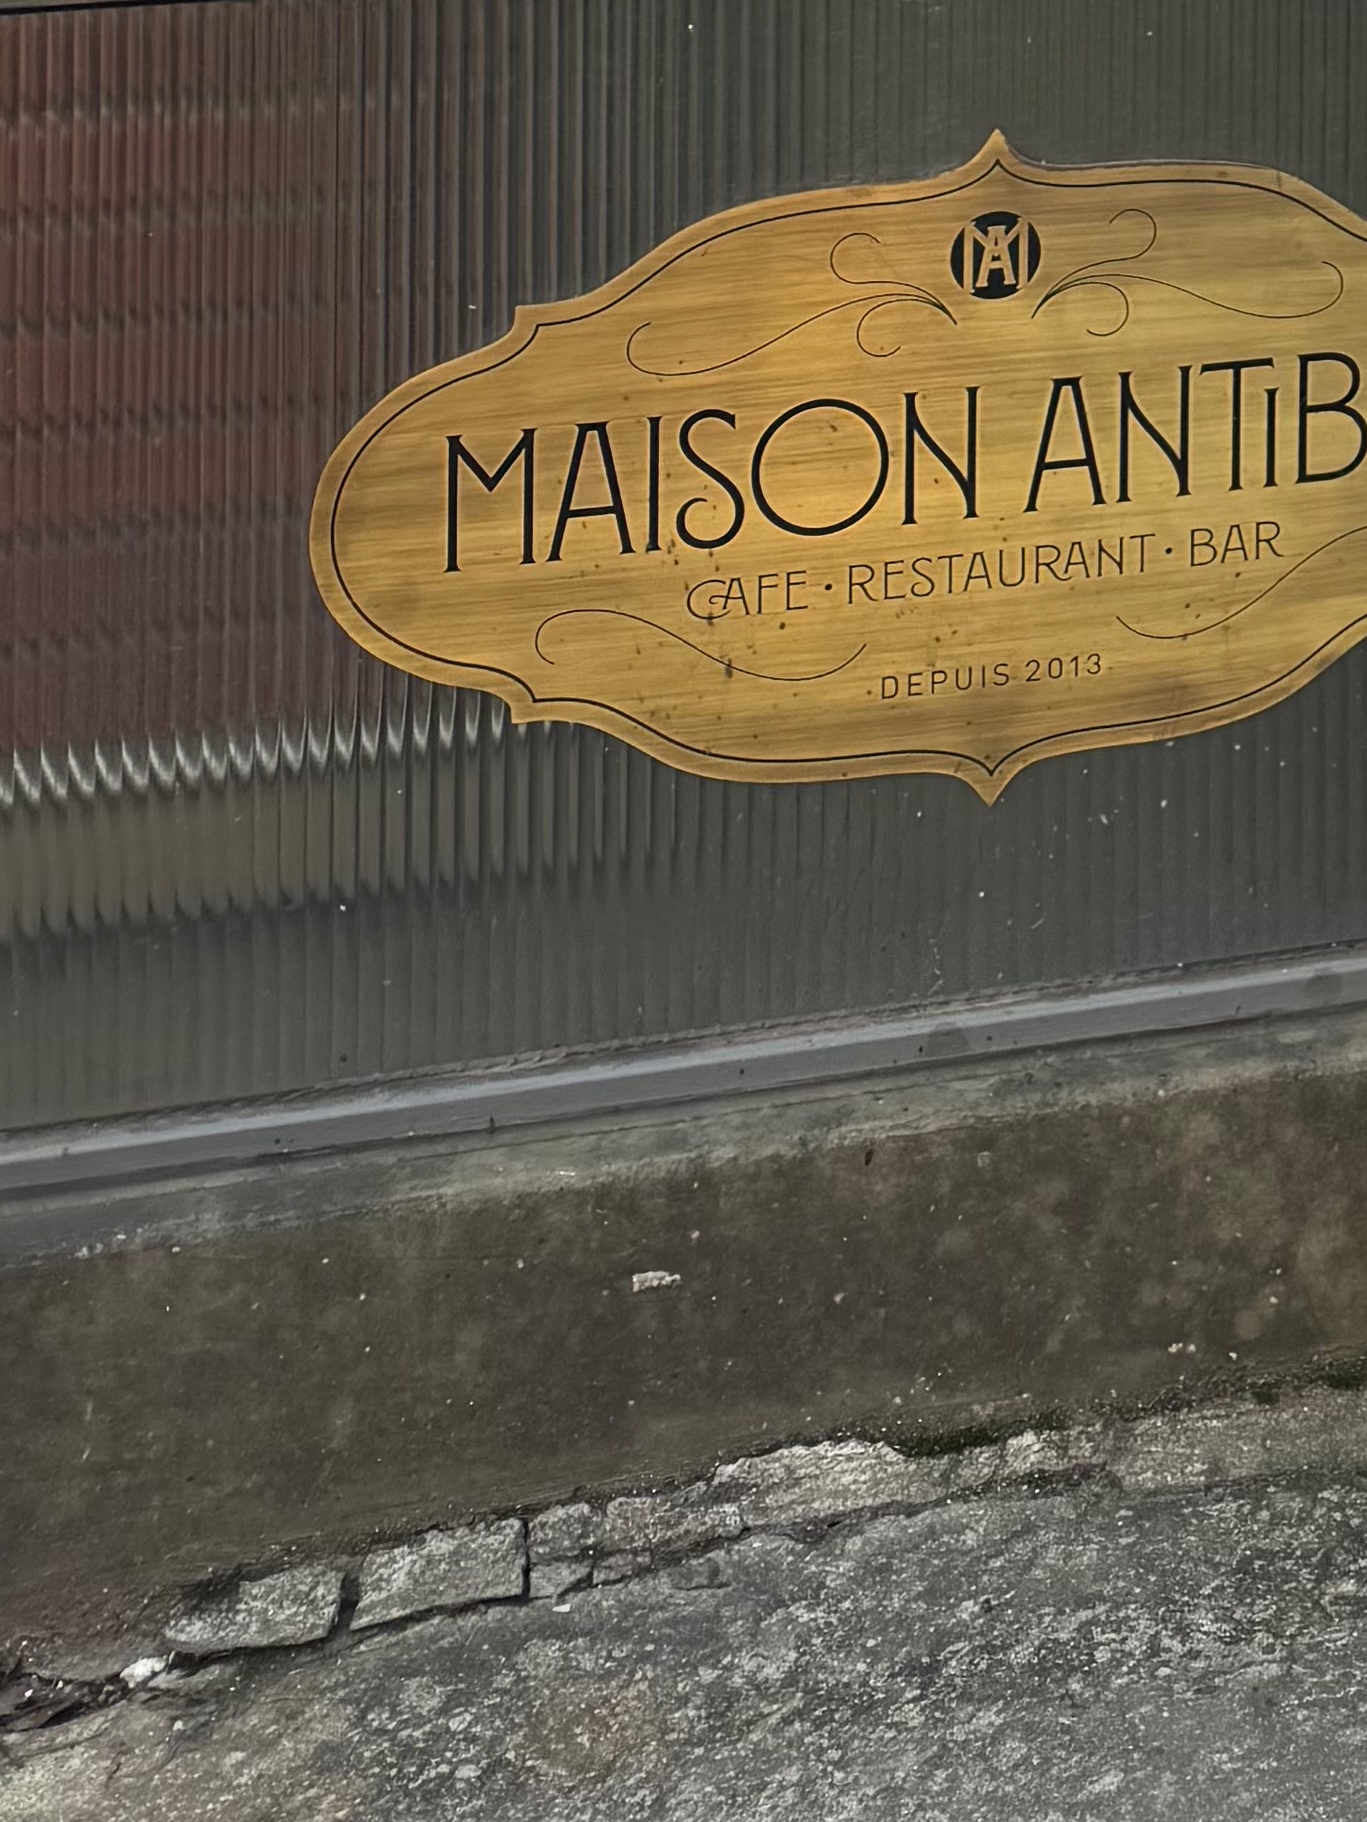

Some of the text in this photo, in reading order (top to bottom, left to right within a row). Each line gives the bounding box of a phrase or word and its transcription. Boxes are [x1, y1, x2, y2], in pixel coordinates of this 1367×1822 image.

[444, 385, 980, 573] MAISON
[846, 533, 1157, 605] RESTAURANT
[1189, 520, 1285, 568] BAR
[881, 652, 1101, 700] DEPUIS 2013
